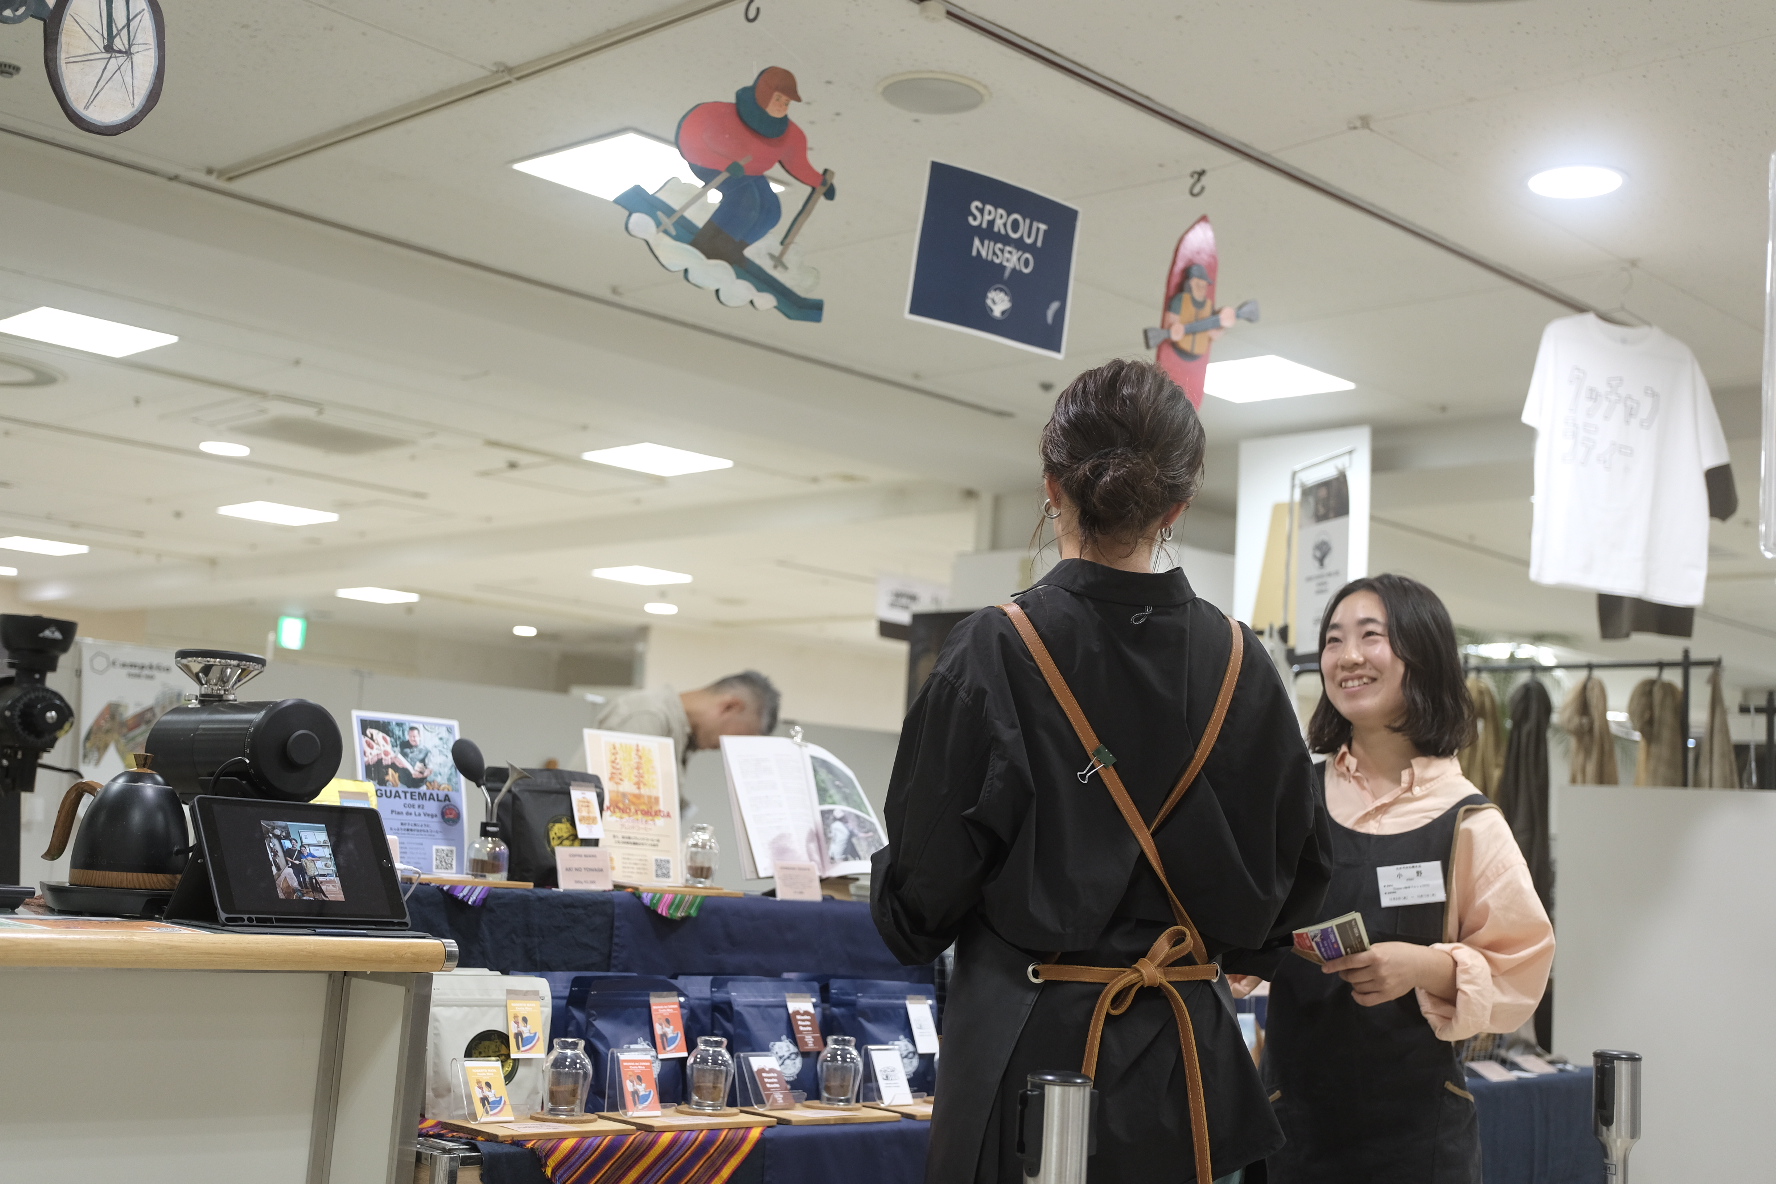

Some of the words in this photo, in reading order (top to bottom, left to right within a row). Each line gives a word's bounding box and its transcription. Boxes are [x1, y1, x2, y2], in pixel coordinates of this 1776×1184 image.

[967, 199, 1048, 248] SPROUT
[971, 235, 1034, 275] NISEKO
[376, 788, 452, 803] GUATEMALA
[423, 811, 439, 819] Vega
